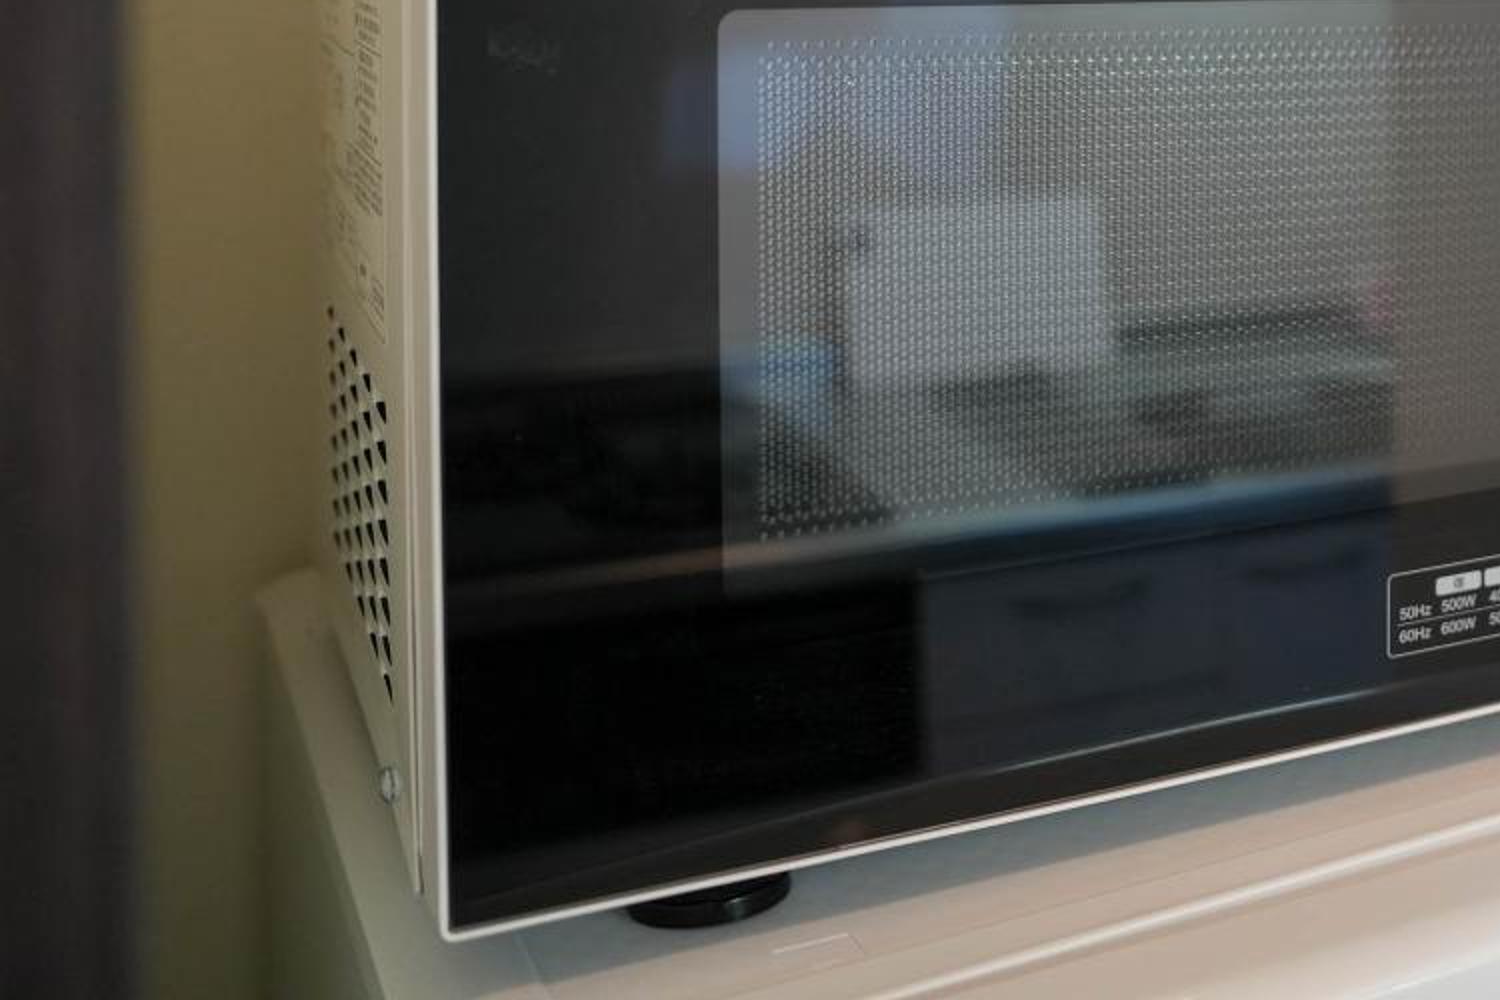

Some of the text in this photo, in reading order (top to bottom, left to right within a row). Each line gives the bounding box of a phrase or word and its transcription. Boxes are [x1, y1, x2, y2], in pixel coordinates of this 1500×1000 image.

[1399, 602, 1433, 622] 50Hz
[1441, 593, 1478, 613] 500W
[1398, 626, 1433, 645] 60Hz
[1441, 615, 1478, 636] 600W
